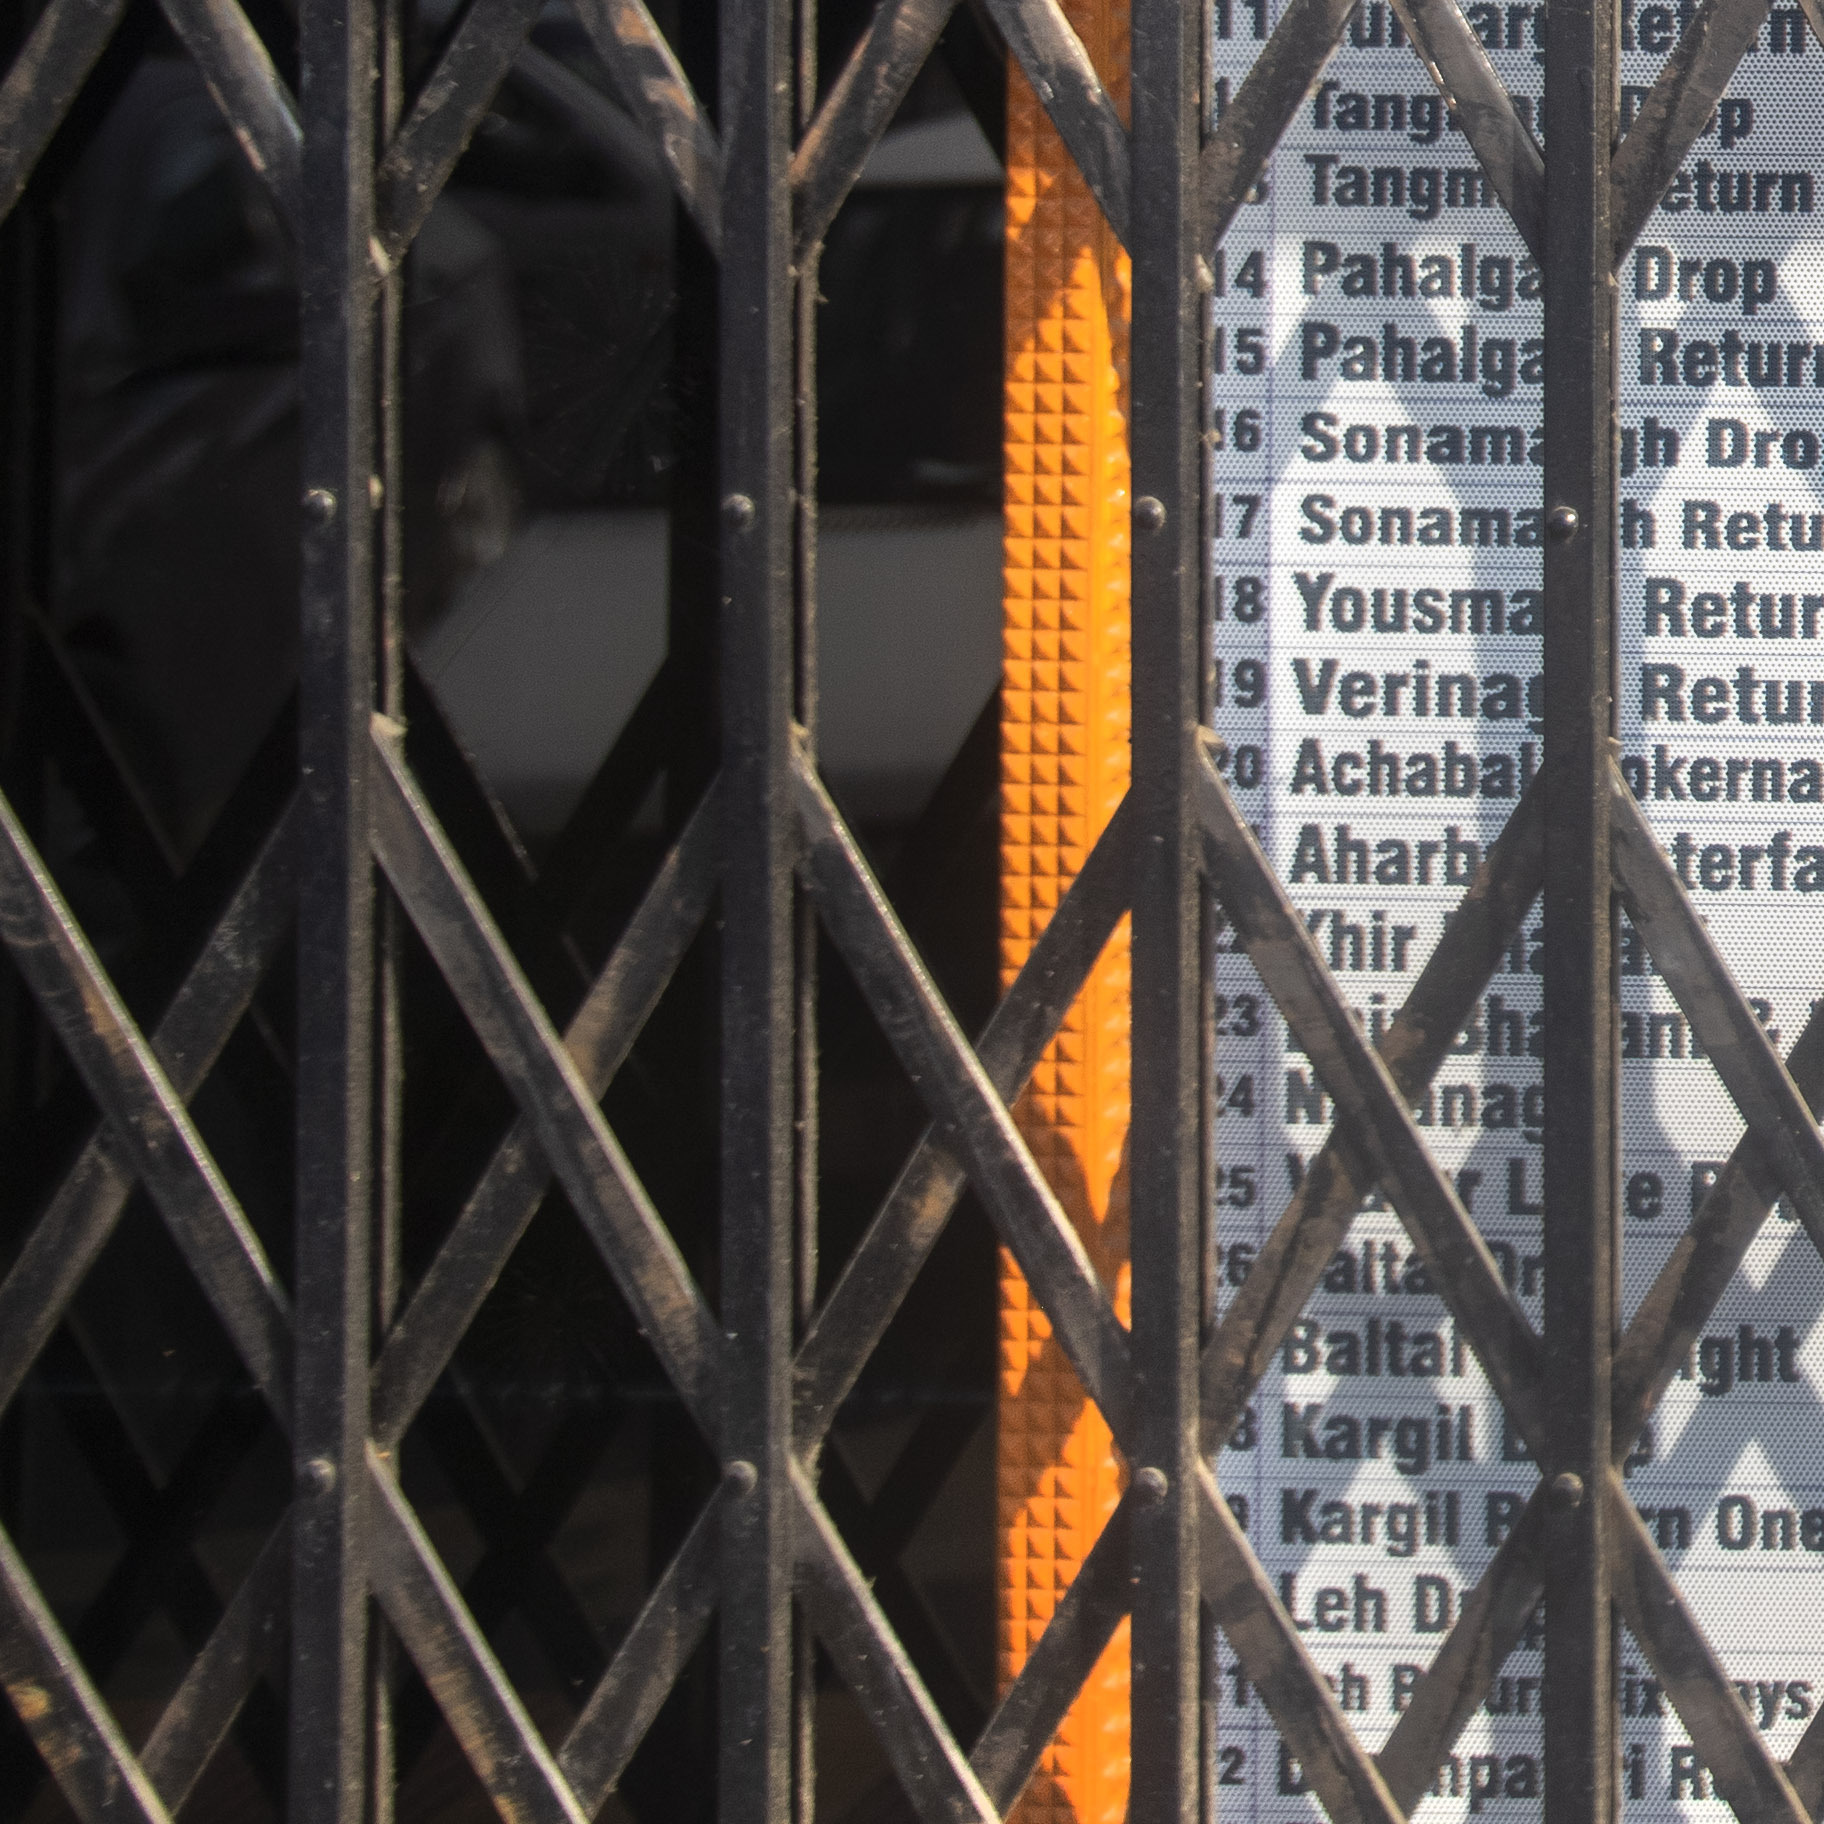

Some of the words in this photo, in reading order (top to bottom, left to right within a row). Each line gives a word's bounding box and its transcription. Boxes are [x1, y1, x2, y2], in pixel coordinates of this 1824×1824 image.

[1658, 160, 1816, 214] eturn
[1214, 248, 1268, 299] 14
[1301, 239, 1545, 313] Pahalga
[1632, 244, 1779, 316] Drop
[1213, 326, 1267, 376] 15
[1300, 322, 1545, 400] Pahalga
[1292, 571, 1545, 636] Yousma
[1281, 1402, 1474, 1476] Kargil
[1280, 1488, 1460, 1557] Kargil
